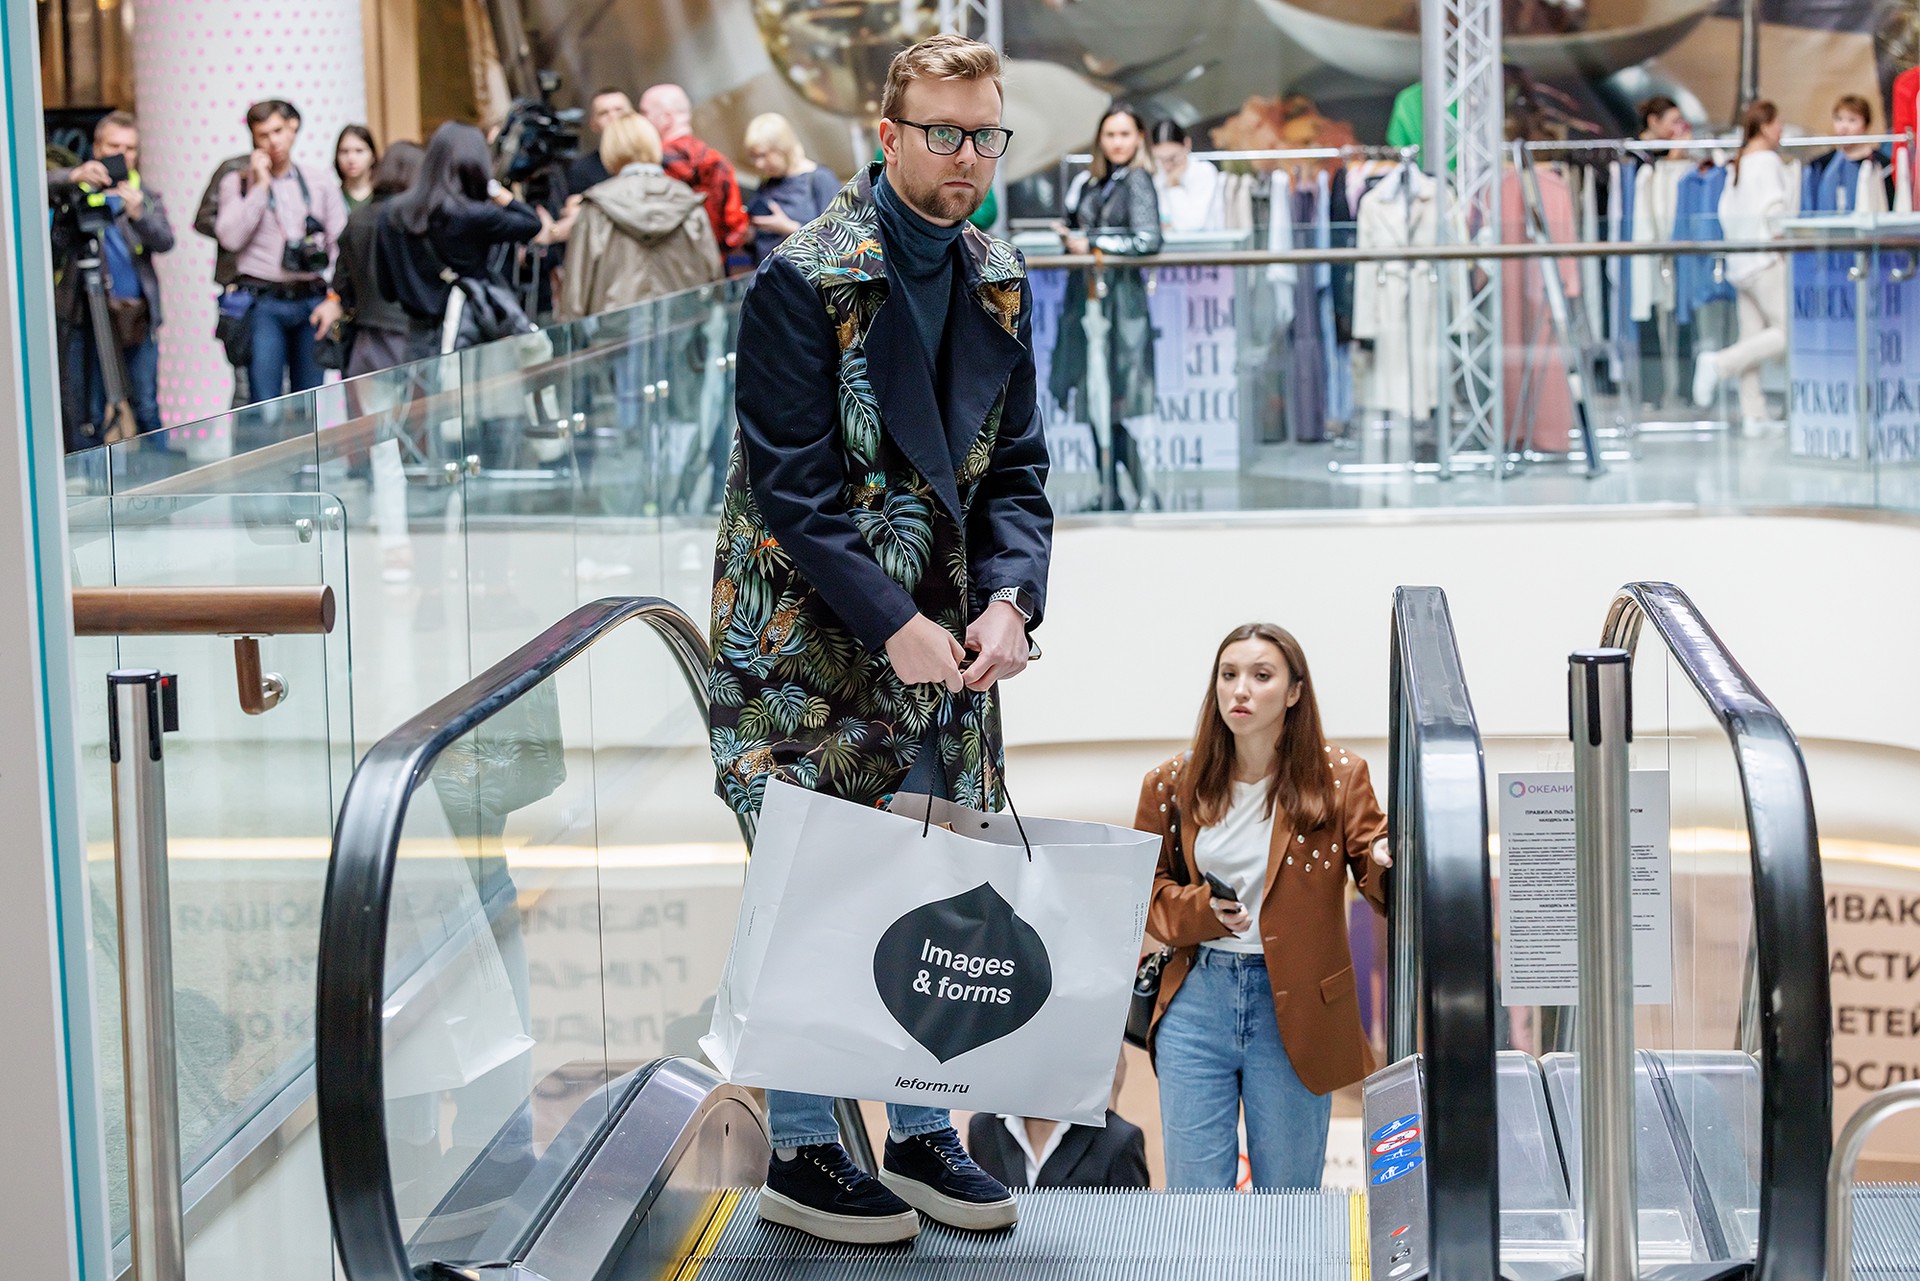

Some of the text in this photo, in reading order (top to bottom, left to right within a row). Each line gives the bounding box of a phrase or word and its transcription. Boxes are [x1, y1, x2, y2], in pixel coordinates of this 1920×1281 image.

[1527, 784, 1574, 794] ОКЕАНИ
[920, 938, 1016, 979] Images
[912, 969, 1012, 1004] & forms
[895, 1076, 970, 1094] leform.ru
